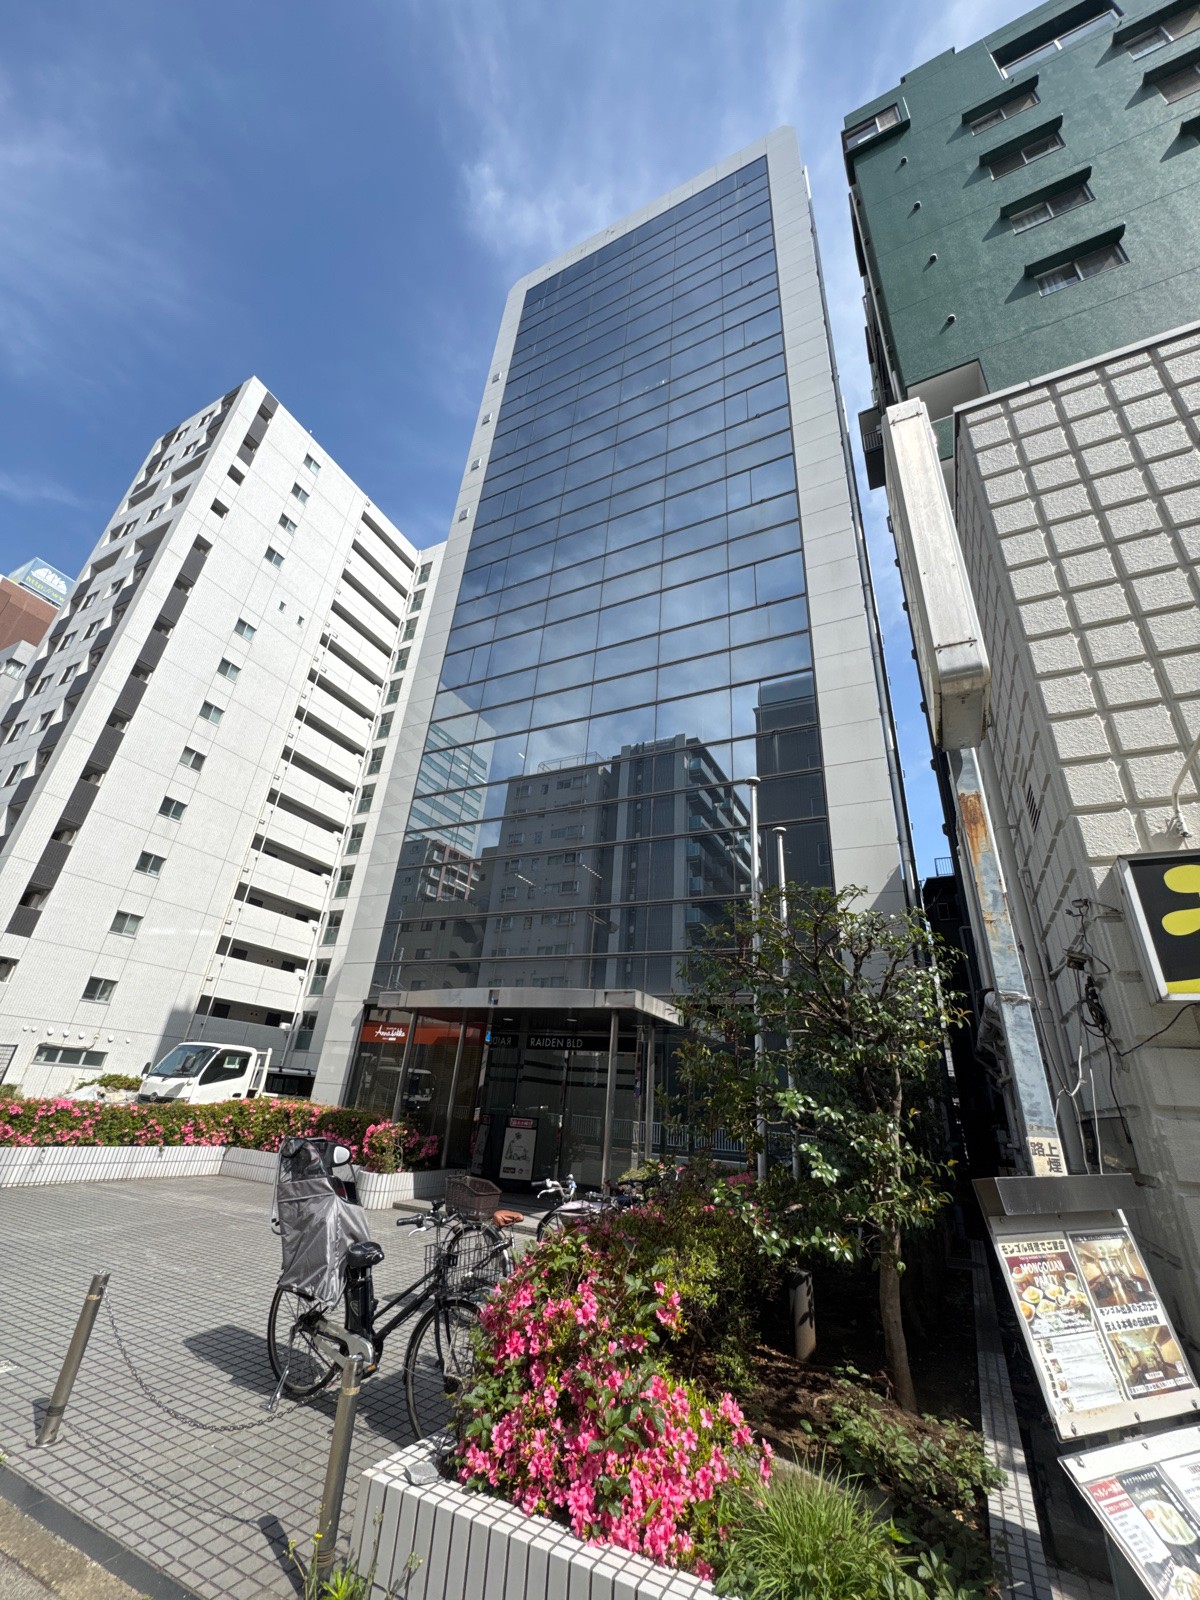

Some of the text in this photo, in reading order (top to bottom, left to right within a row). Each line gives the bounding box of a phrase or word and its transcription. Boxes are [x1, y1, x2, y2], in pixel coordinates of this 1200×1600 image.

[530, 1038, 583, 1048] RAIDEN BLD
[1030, 1142, 1060, 1157] 路上
[1019, 1259, 1066, 1274] MONGOLIAN
[1034, 1274, 1060, 1287] PARTY
